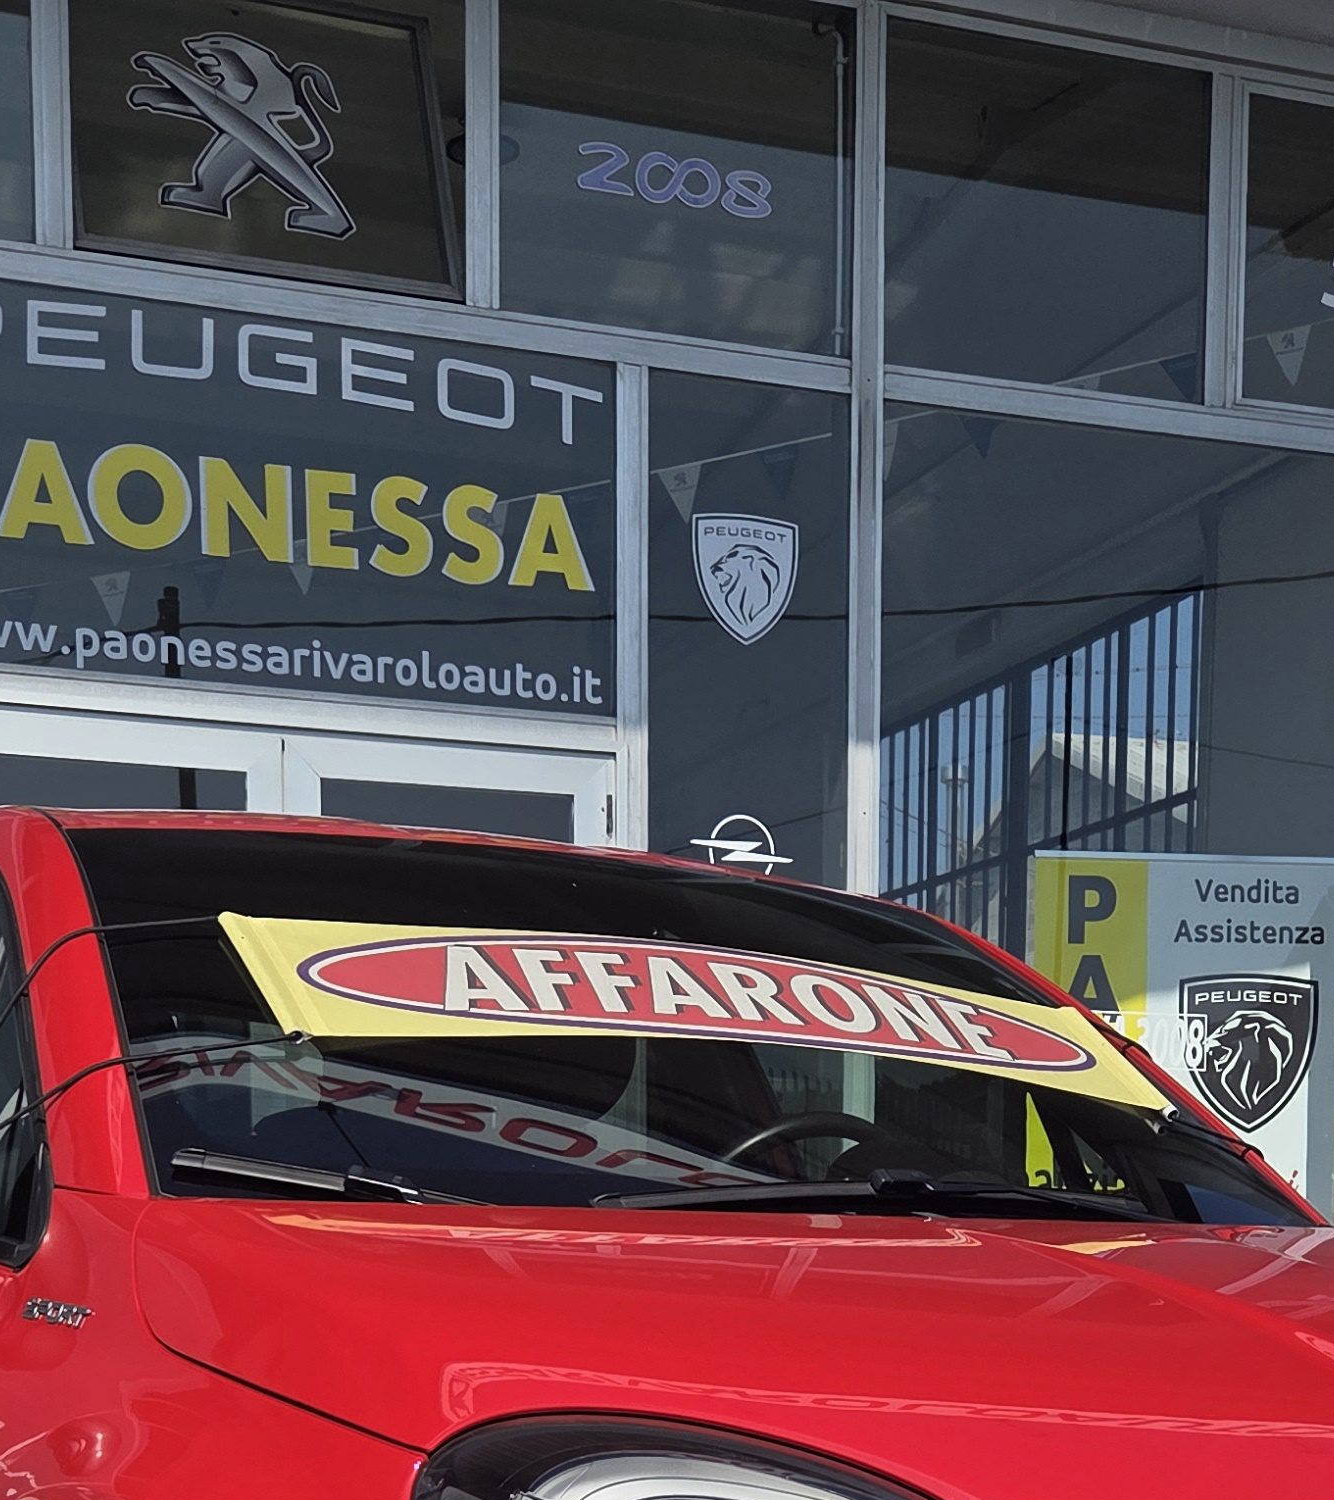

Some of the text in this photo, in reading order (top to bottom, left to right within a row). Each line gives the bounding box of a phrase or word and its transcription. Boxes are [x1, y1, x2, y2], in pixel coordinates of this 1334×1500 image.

[577, 142, 772, 219] 2008
[704, 526, 787, 543] PEUGEOT
[1195, 879, 1299, 904] Vendita
[1174, 919, 1325, 945] Assistenza
[443, 944, 1015, 1062] AFFARONE
[1194, 990, 1303, 1006] PEUGEOT
